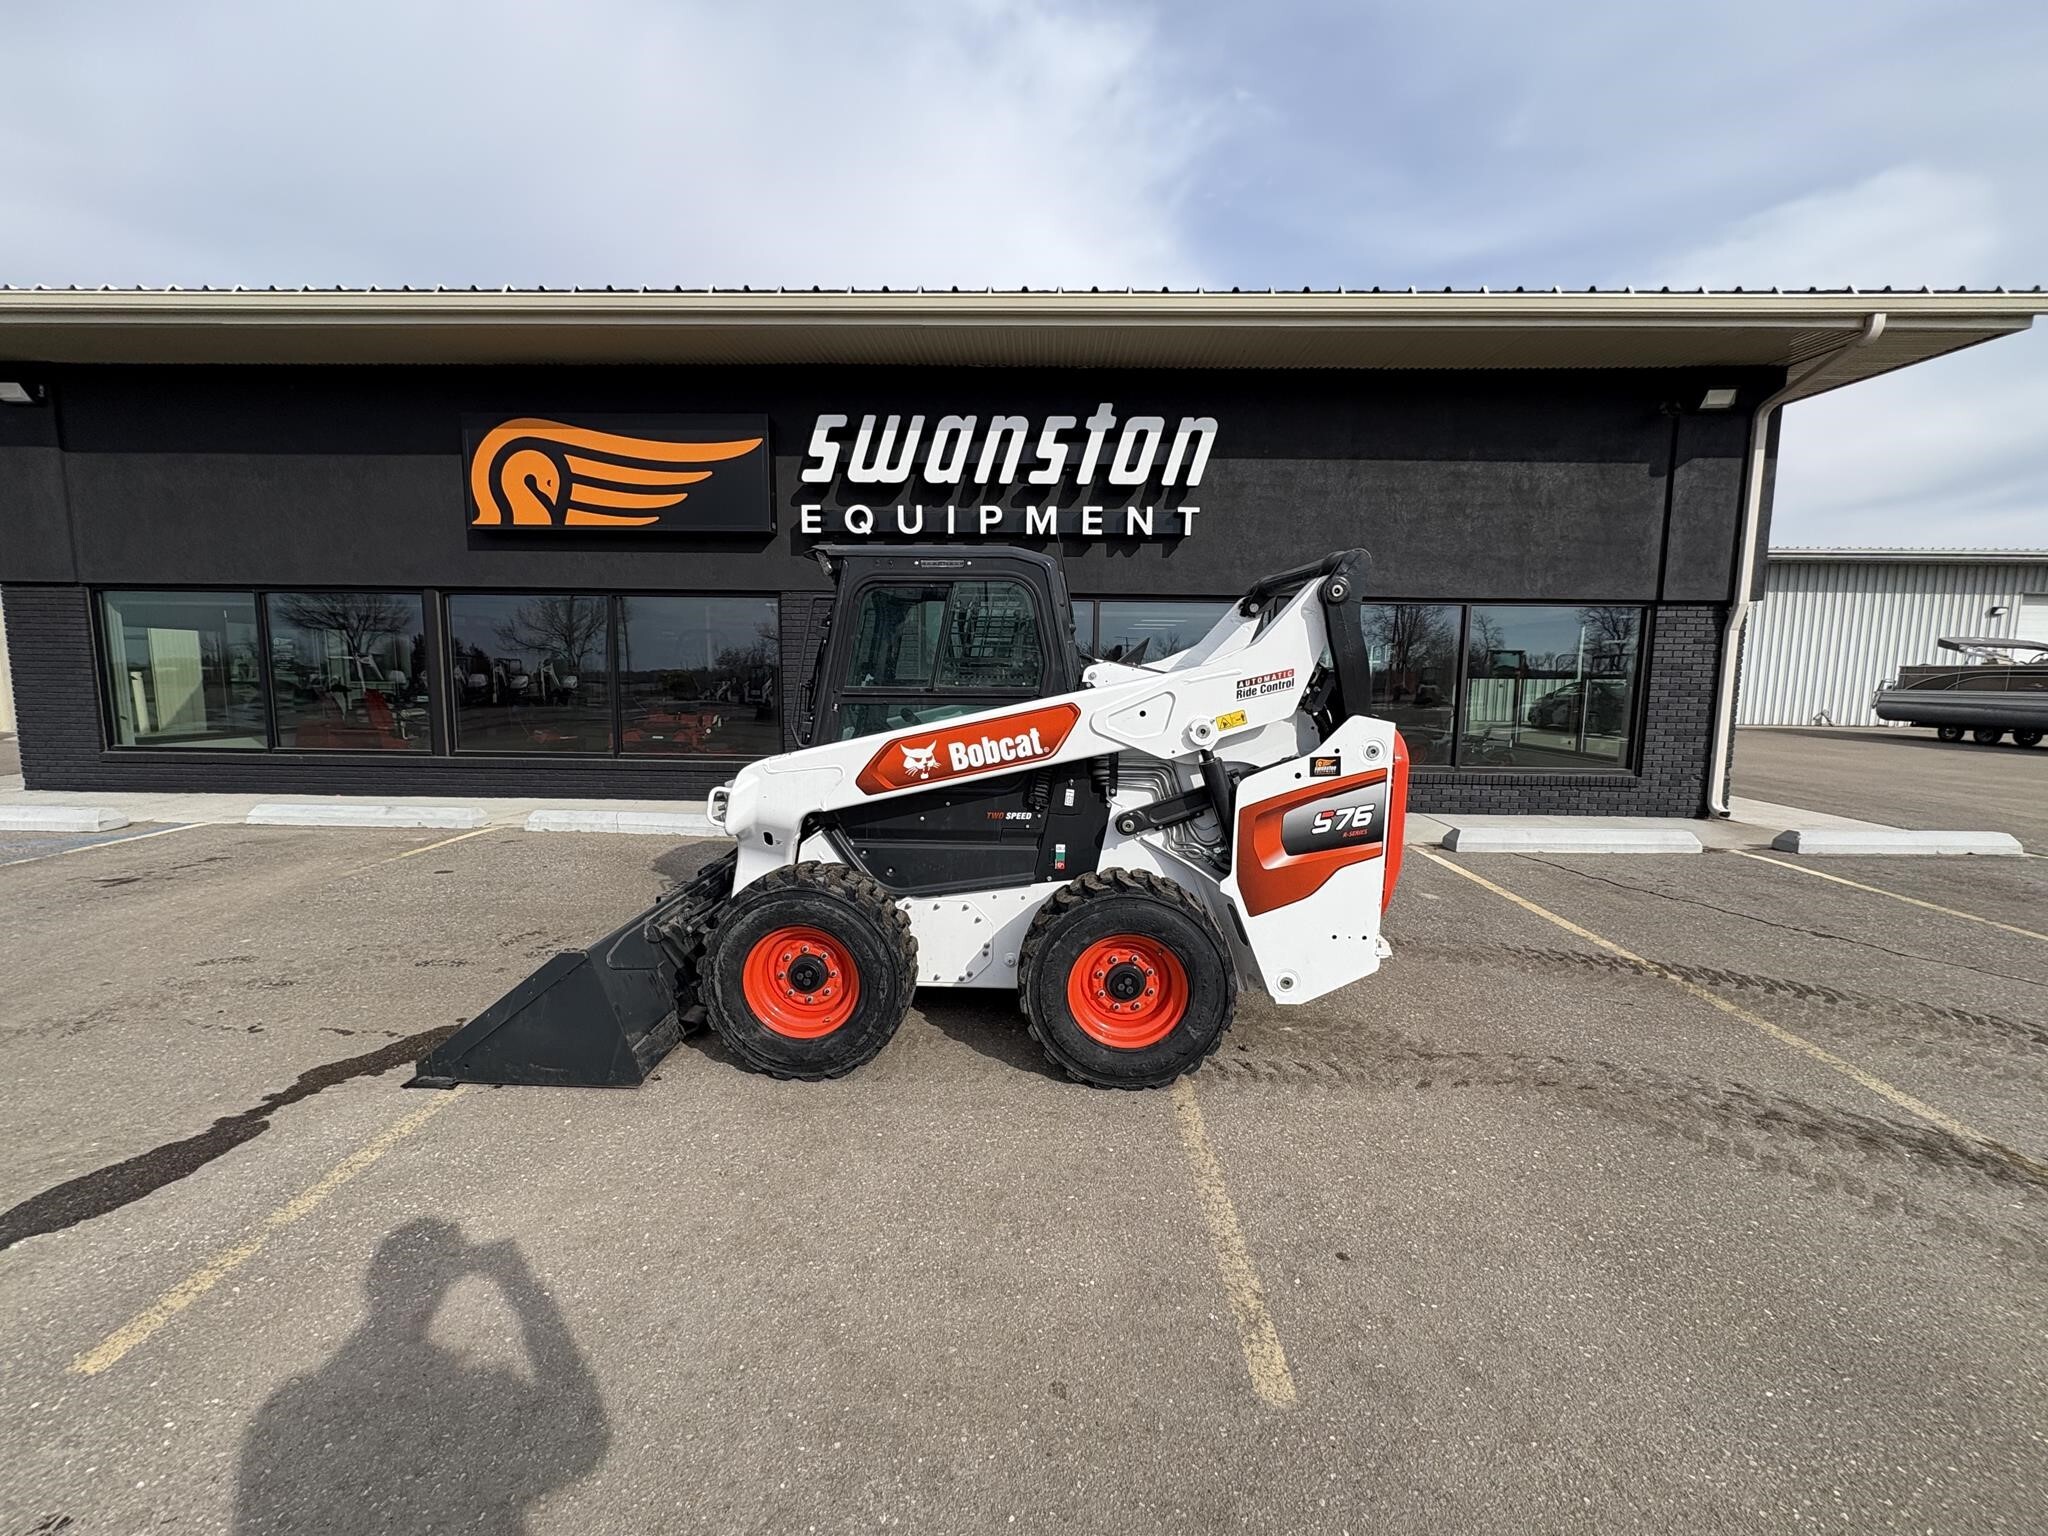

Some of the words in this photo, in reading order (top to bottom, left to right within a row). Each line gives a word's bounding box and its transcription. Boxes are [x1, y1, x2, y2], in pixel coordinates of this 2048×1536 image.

[801, 504, 1200, 535] EQUIPMENT
[1236, 687, 1257, 699] Ride
[1260, 678, 1295, 694] Control
[1238, 670, 1293, 687] AUTOMATIC
[948, 727, 1043, 771] Bobcat
[986, 811, 1004, 820] TWO
[1005, 812, 1032, 820] SPEED
[1311, 804, 1375, 835] S76
